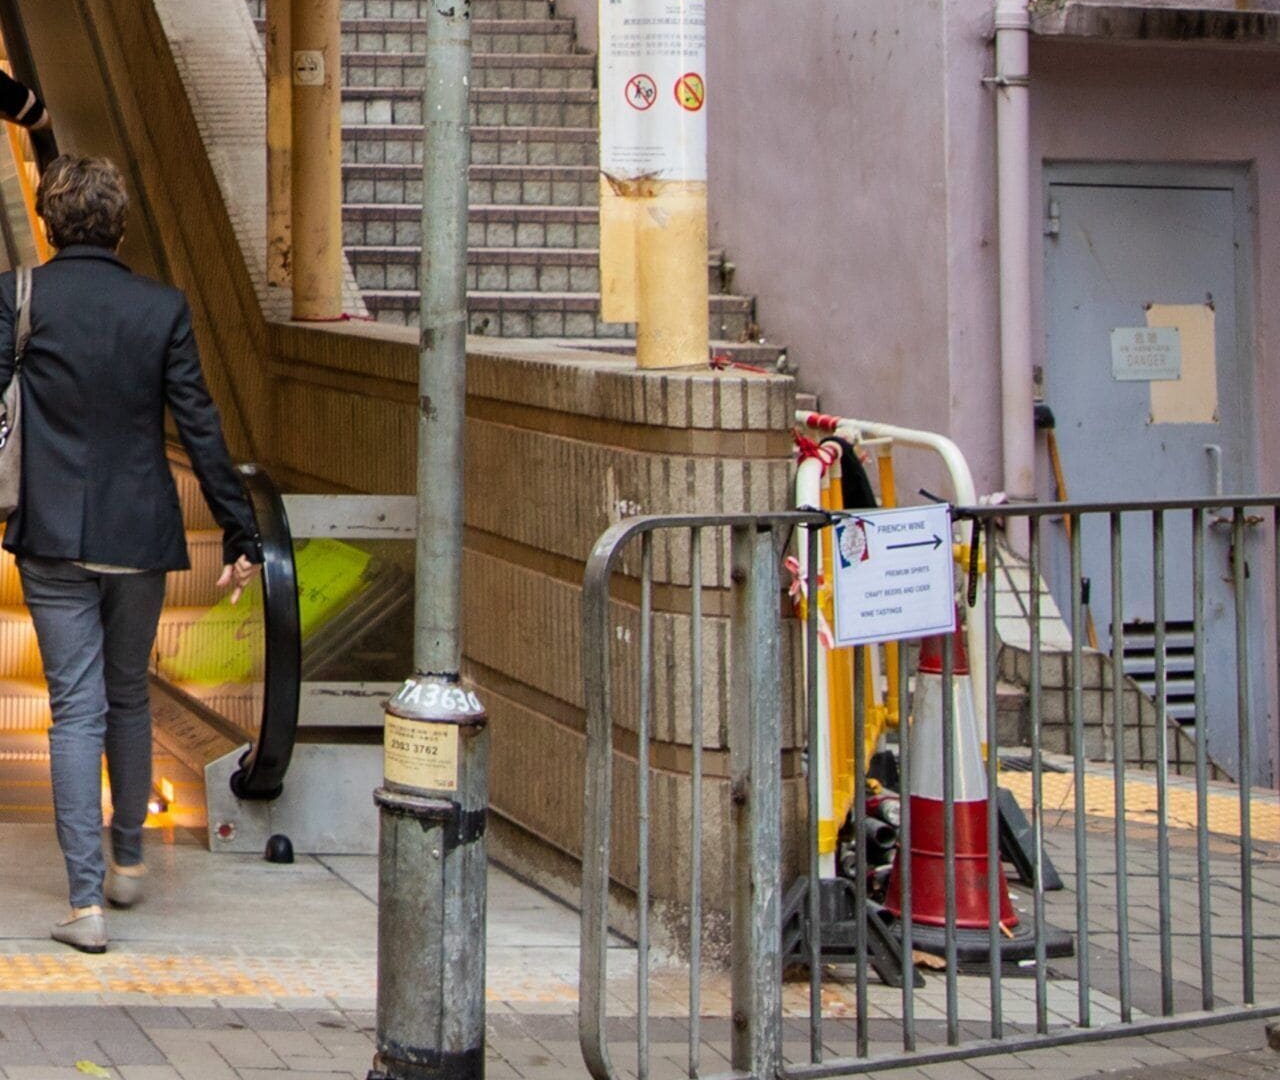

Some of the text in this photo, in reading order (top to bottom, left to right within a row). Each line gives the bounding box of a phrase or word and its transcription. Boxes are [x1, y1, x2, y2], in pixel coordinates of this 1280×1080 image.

[1127, 353, 1167, 367] DANGER
[877, 521, 925, 534] FRENCH WINE
